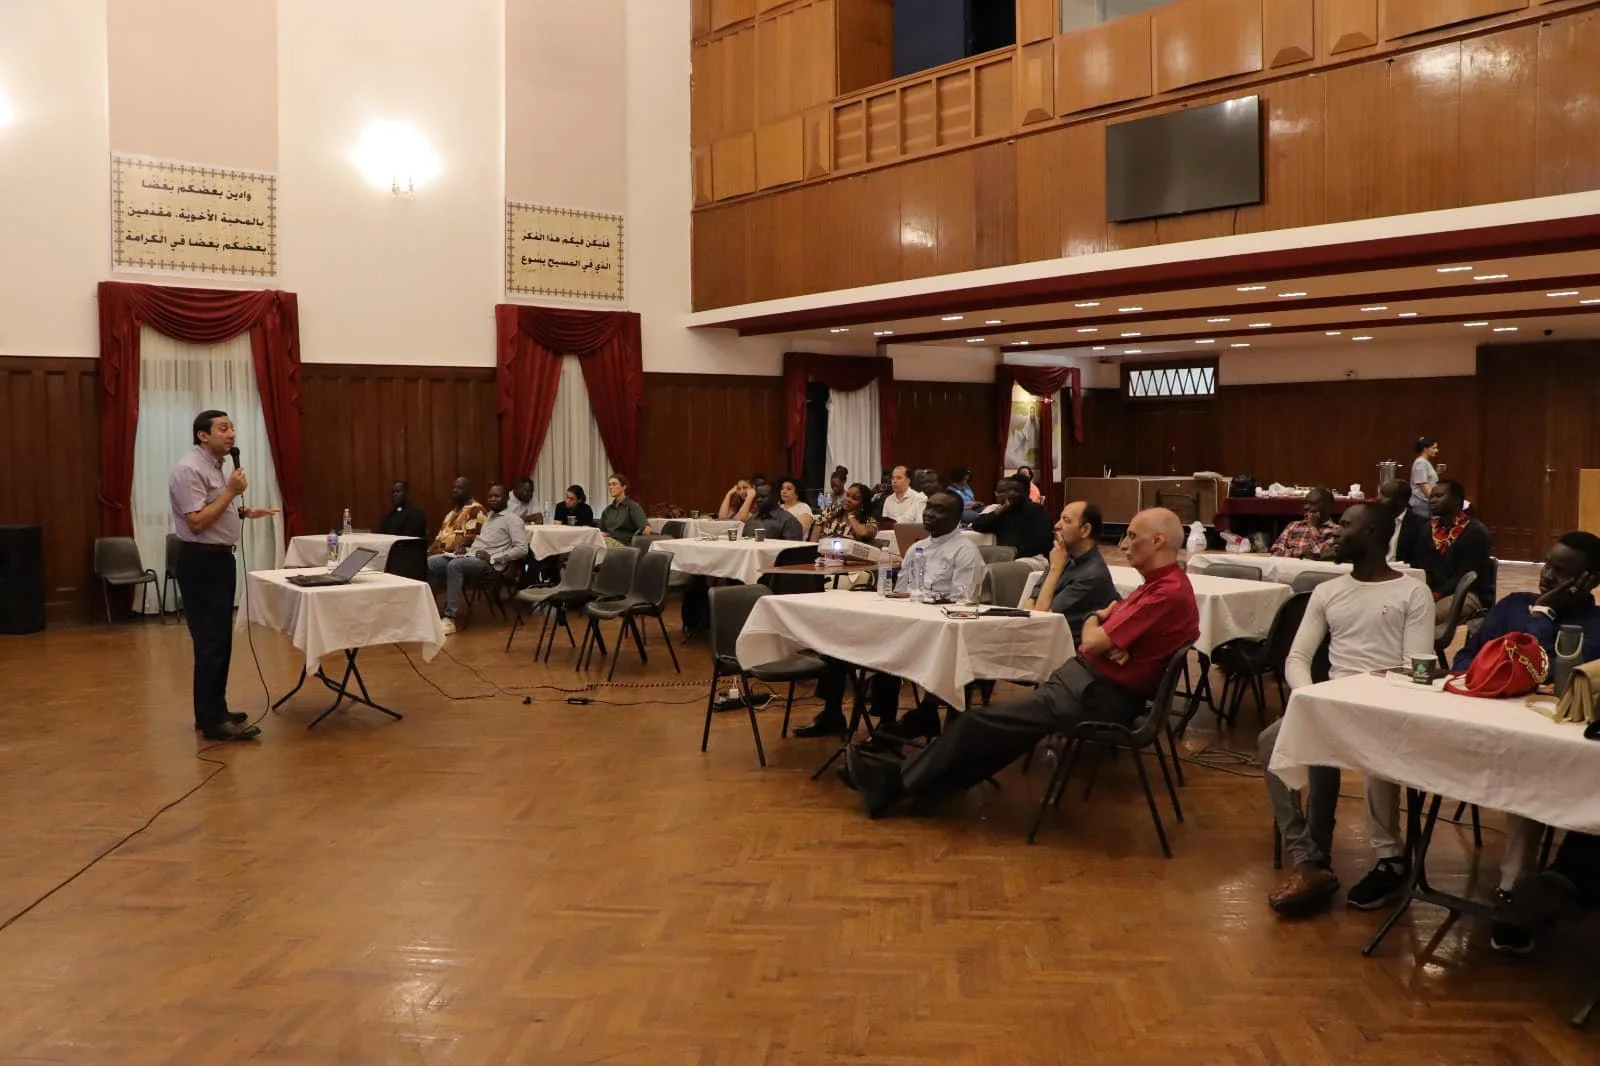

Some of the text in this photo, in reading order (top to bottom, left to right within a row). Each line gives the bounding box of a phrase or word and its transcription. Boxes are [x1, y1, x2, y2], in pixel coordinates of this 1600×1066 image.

[142, 179, 174, 193] بعضا
[177, 183, 223, 198] بعضكم
[220, 212, 264, 230] بالمحبة
[125, 230, 267, 255] بعضكم بعضا في الكرامة
[521, 231, 610, 250] فليكن فيكم هذا الفكر
[521, 255, 610, 274] الذي في المسيح يسوع
